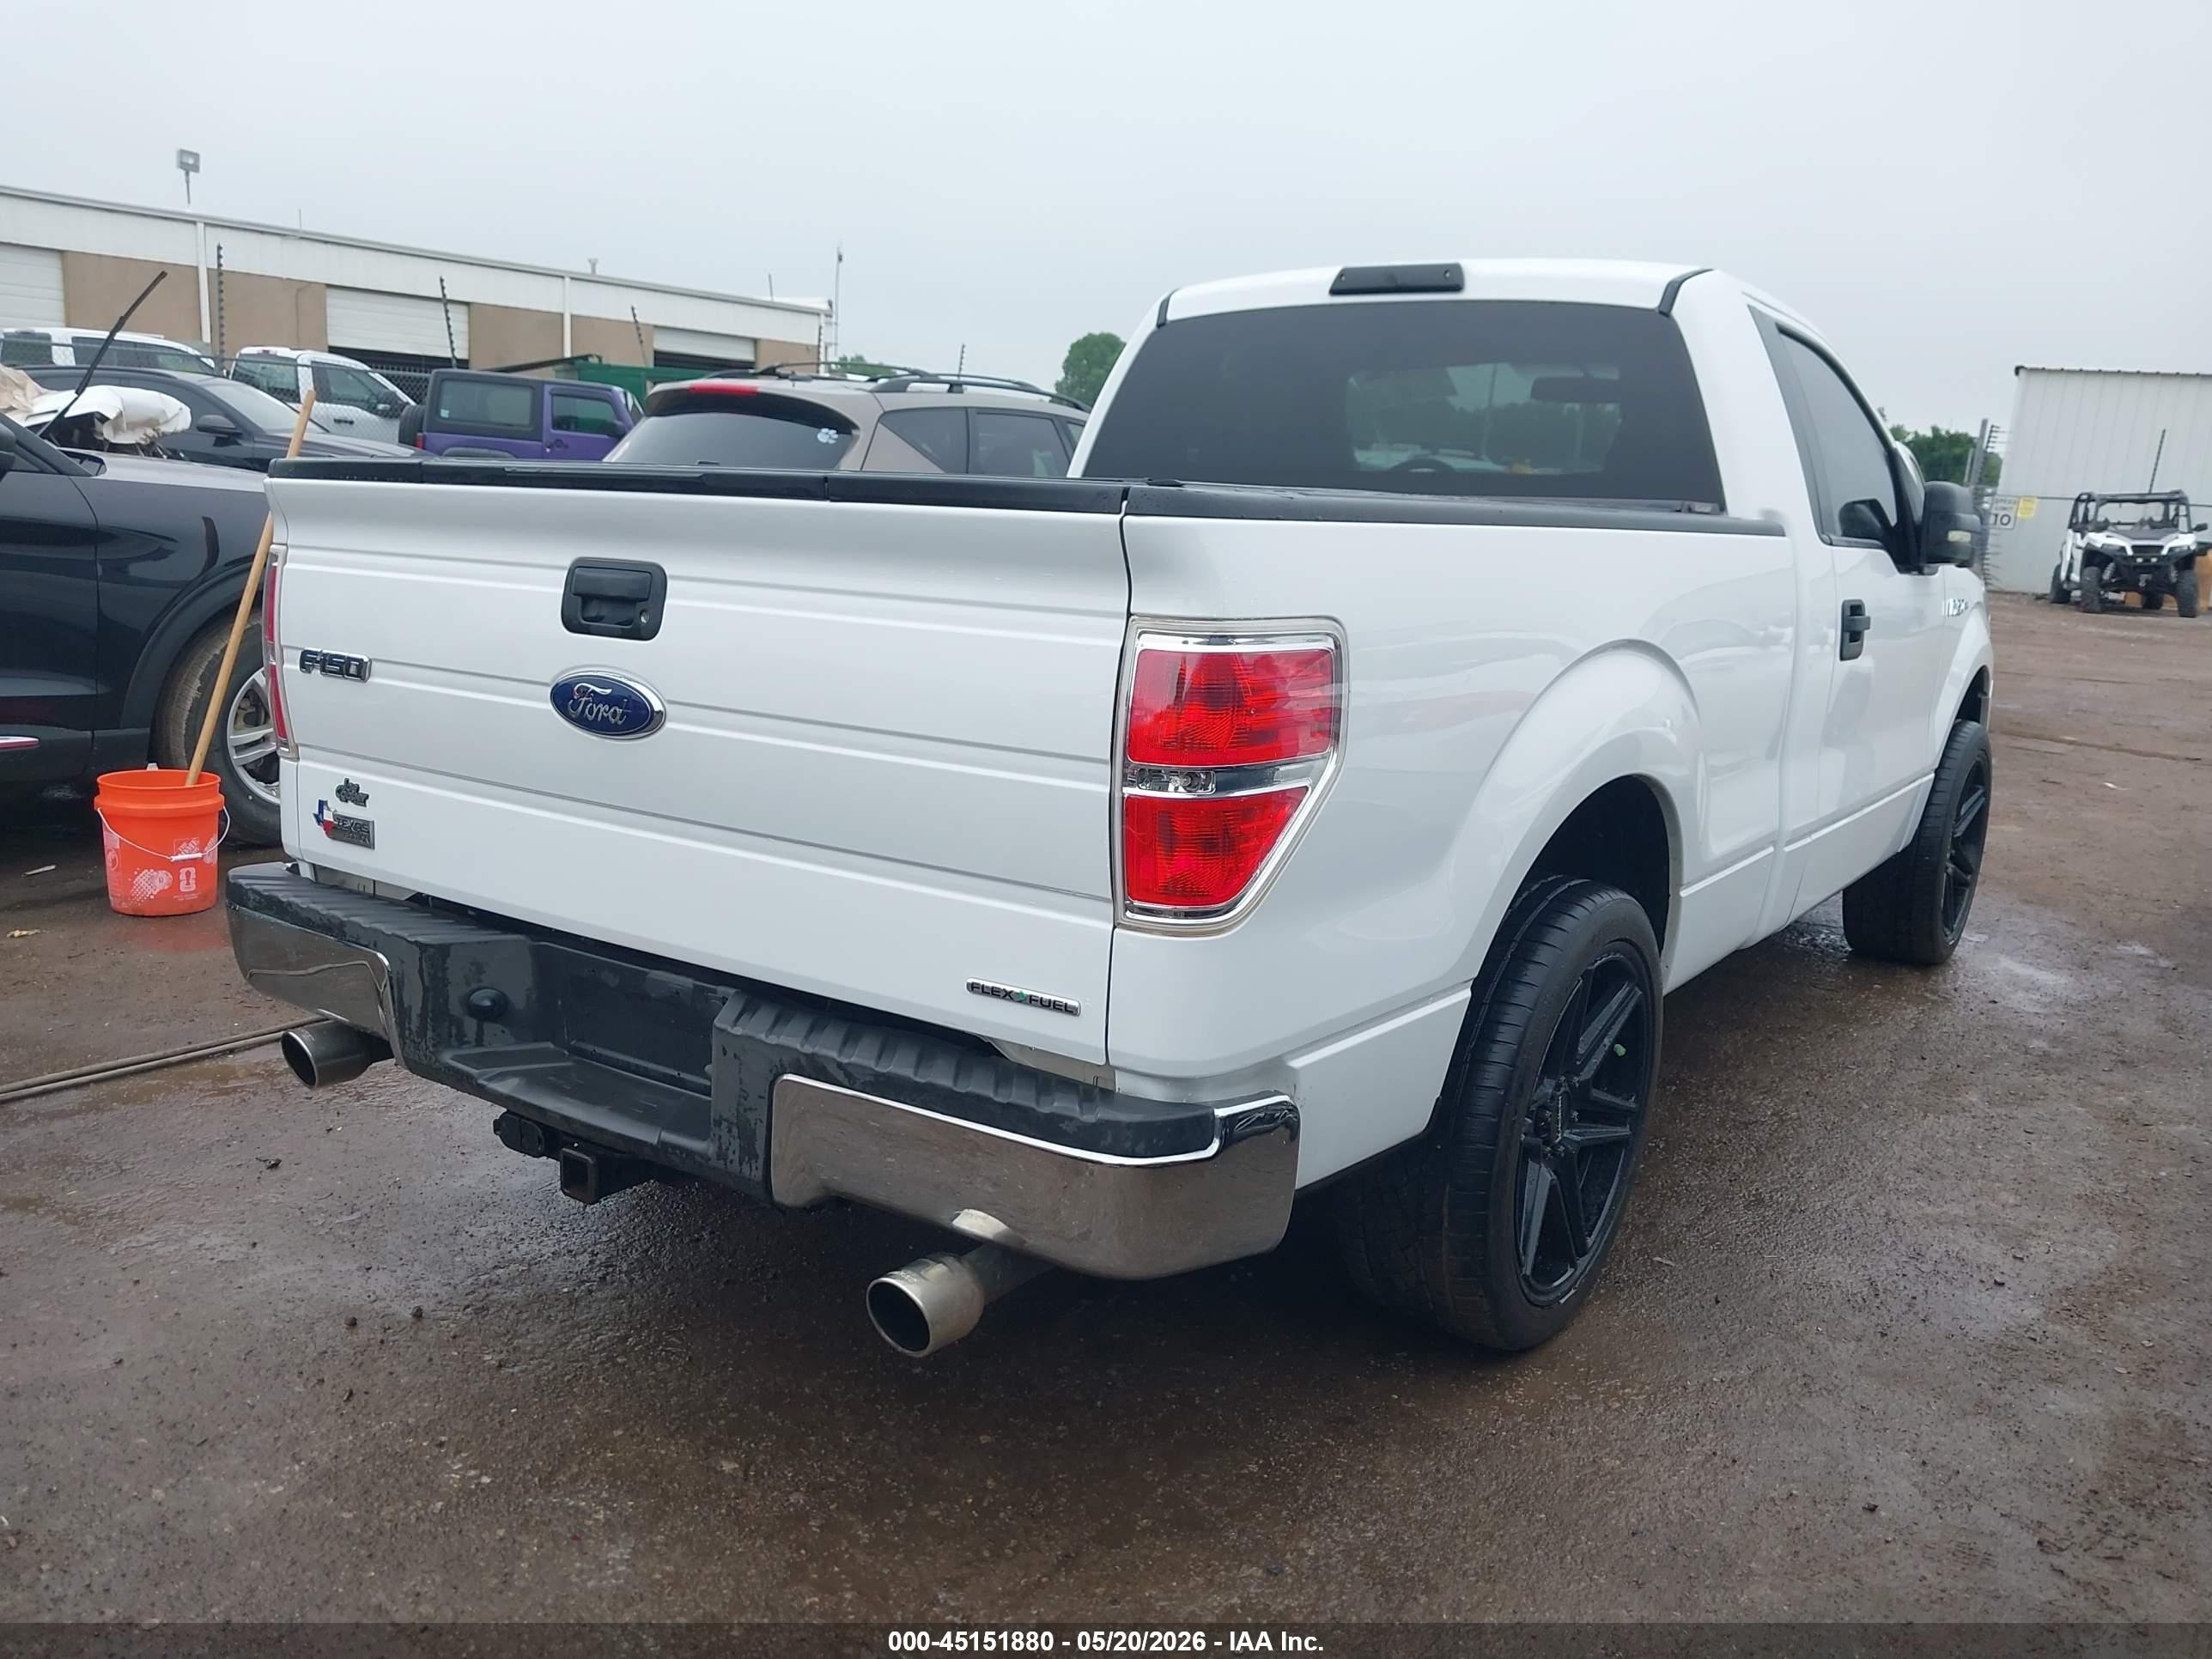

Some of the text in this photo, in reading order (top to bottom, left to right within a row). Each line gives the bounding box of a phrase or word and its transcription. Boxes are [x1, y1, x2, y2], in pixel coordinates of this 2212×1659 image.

[1993, 514, 2011, 526] 10
[568, 683, 632, 726] Ford
[336, 817, 370, 833] TEXAS
[970, 981, 1075, 1013] FLEX FUEL
